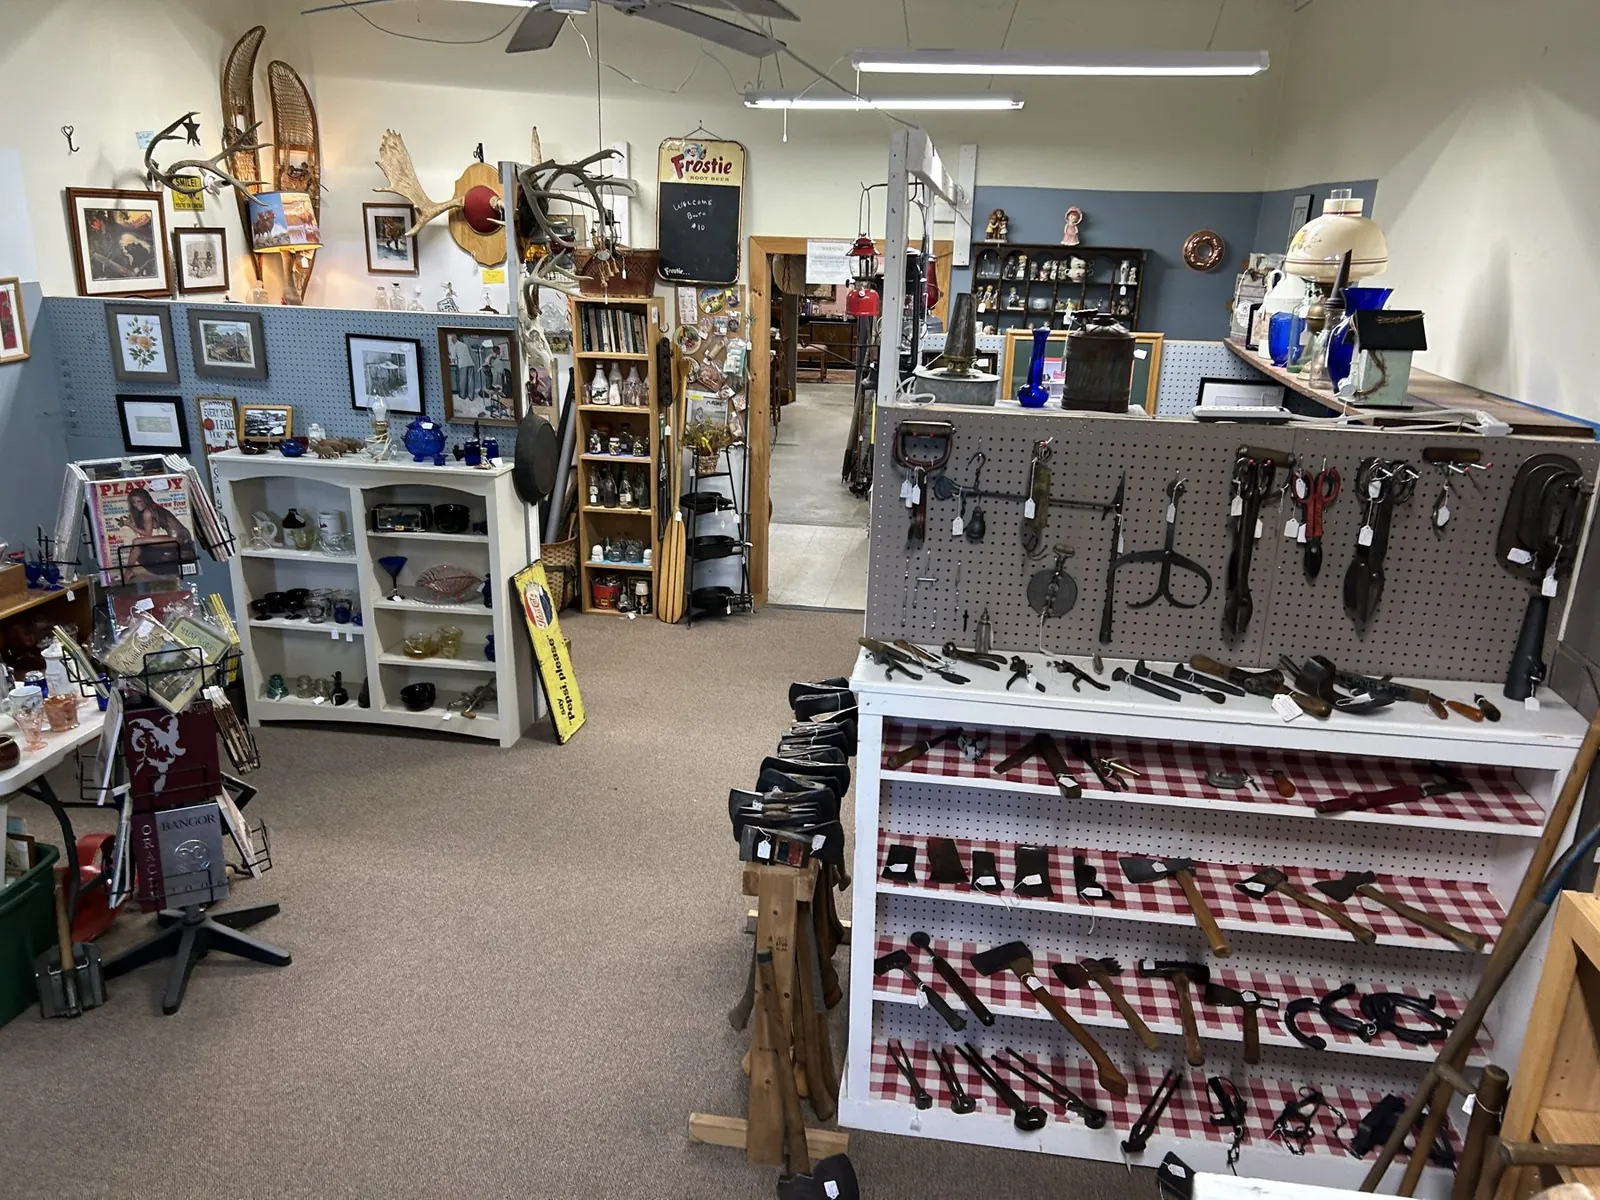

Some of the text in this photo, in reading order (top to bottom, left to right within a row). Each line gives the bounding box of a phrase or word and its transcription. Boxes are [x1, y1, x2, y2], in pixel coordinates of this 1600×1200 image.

[671, 153, 733, 179] Frostie
[204, 408, 219, 418] EVERY
[220, 420, 236, 430] FALL
[101, 478, 183, 496] PLAYY
[557, 698, 566, 715] say
[161, 813, 216, 832] BANGOR
